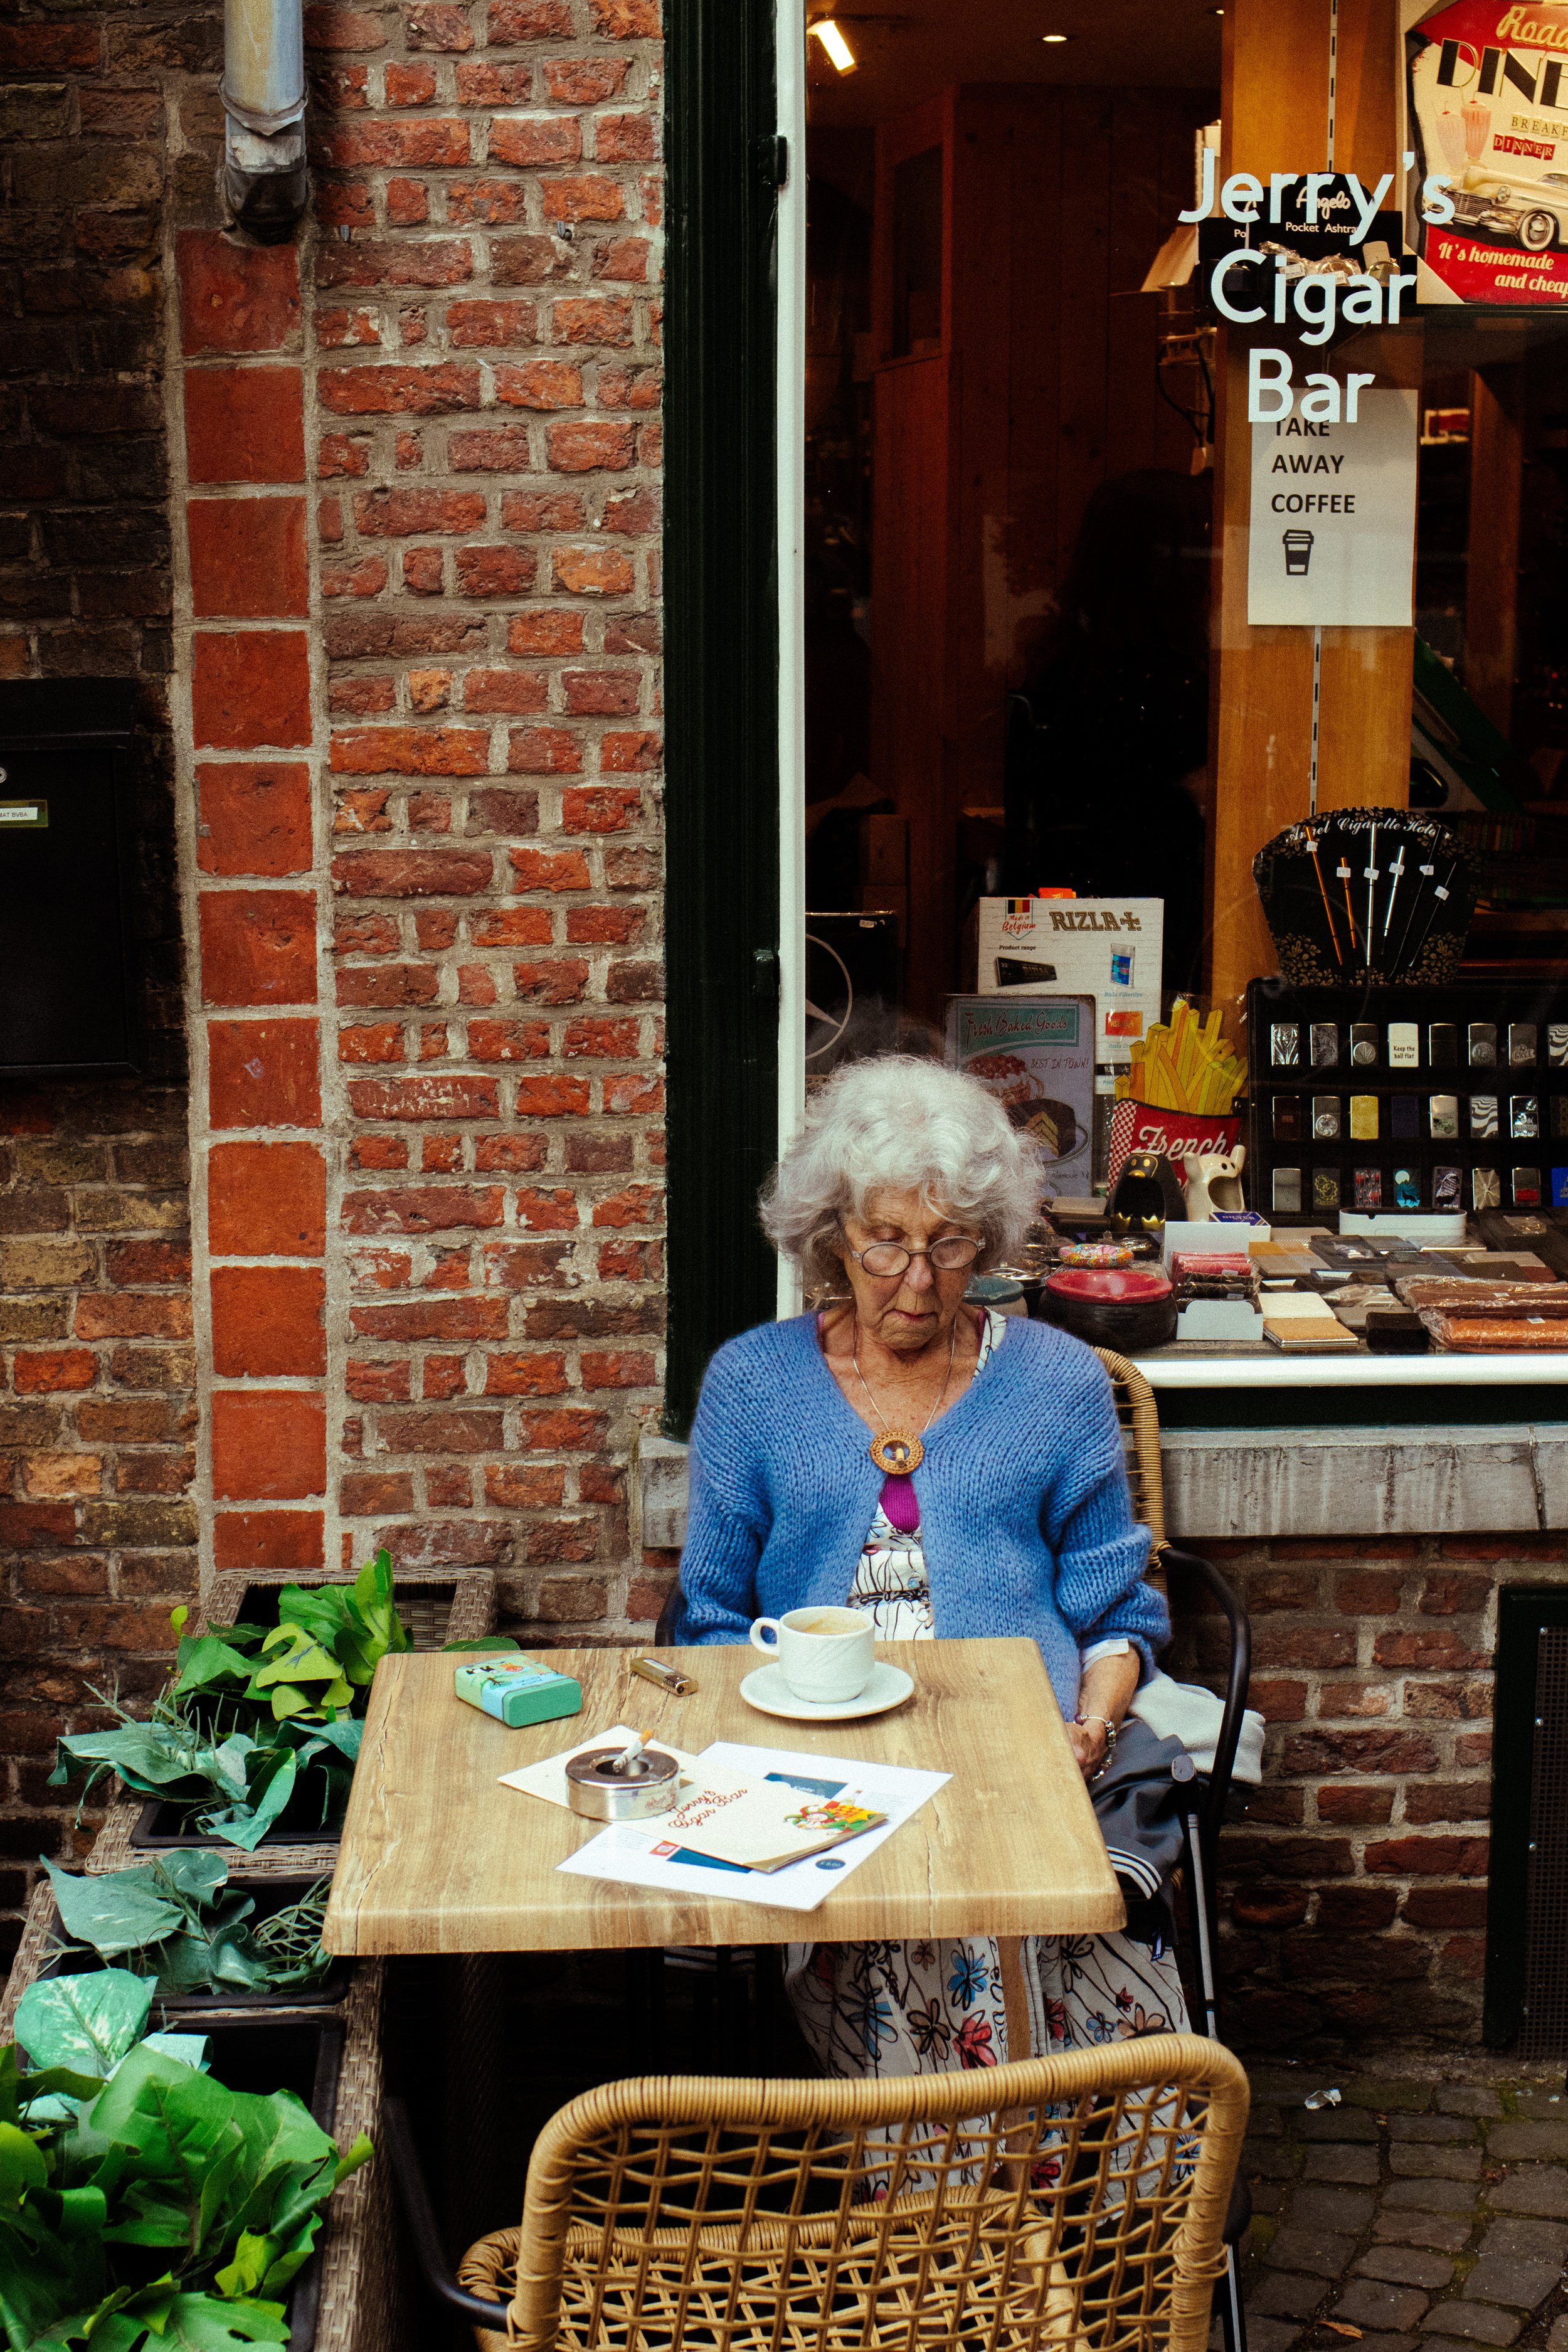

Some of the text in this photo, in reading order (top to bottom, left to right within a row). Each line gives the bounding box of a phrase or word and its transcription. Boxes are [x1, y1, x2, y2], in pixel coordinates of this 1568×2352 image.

[1494, 136, 1553, 157] DINNER
[1177, 148, 1455, 246] Jerry's
[1286, 221, 1357, 234] Pocket Ashtra
[1438, 242, 1554, 270] It's homemade
[1495, 273, 1527, 289] and
[1211, 249, 1417, 346] Cigar
[1248, 348, 1375, 422] Bar
[1276, 418, 1330, 437] TAKE
[1271, 455, 1344, 474] AWAY
[1271, 494, 1355, 513] COFFEE
[1002, 921, 1036, 935] Belgium
[964, 1011, 1067, 1050] Fresh Baked Goods
[1030, 1057, 1089, 1069] BEST IN TOWN!
[1133, 1125, 1228, 1161] French
[669, 1789, 748, 1828] Cigar Bar
[670, 1789, 716, 1820] Jerry's
